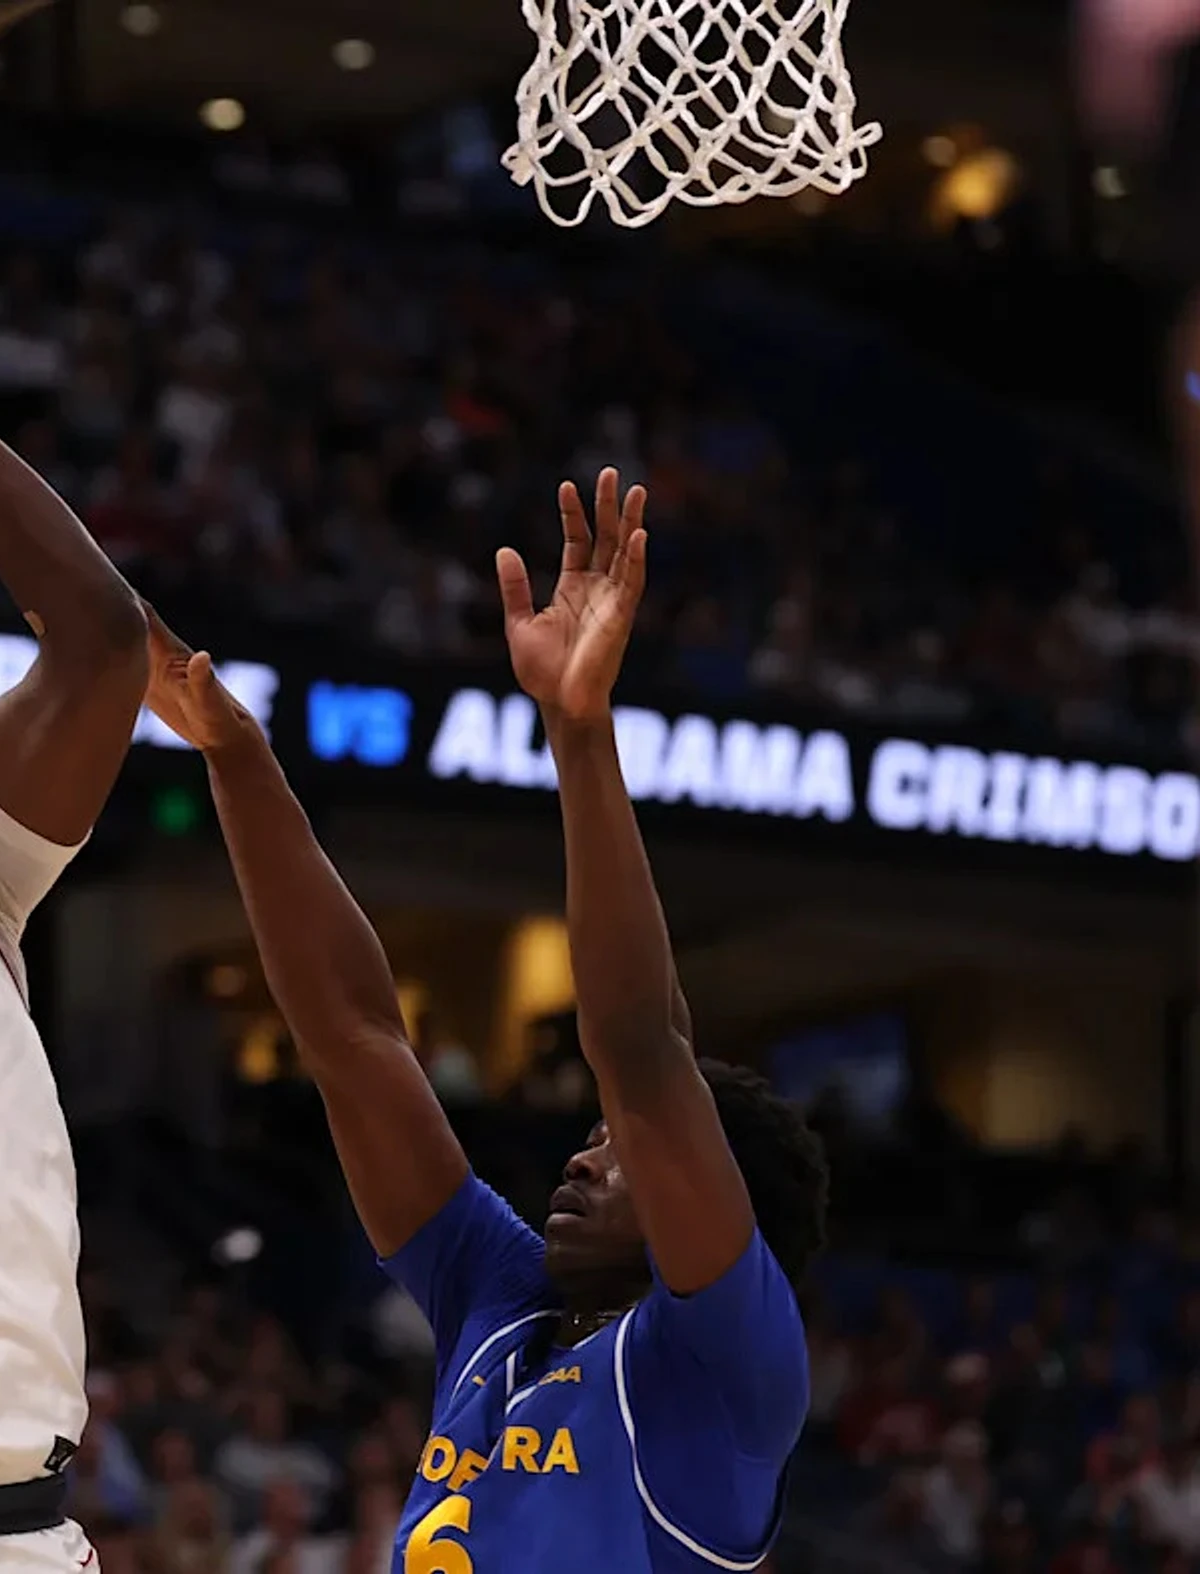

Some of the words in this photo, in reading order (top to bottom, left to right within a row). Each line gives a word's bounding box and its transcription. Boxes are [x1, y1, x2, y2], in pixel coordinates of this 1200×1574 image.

[308, 679, 413, 767] VS
[428, 688, 854, 823] ALBAMA
[404, 1495, 473, 1574] 6
